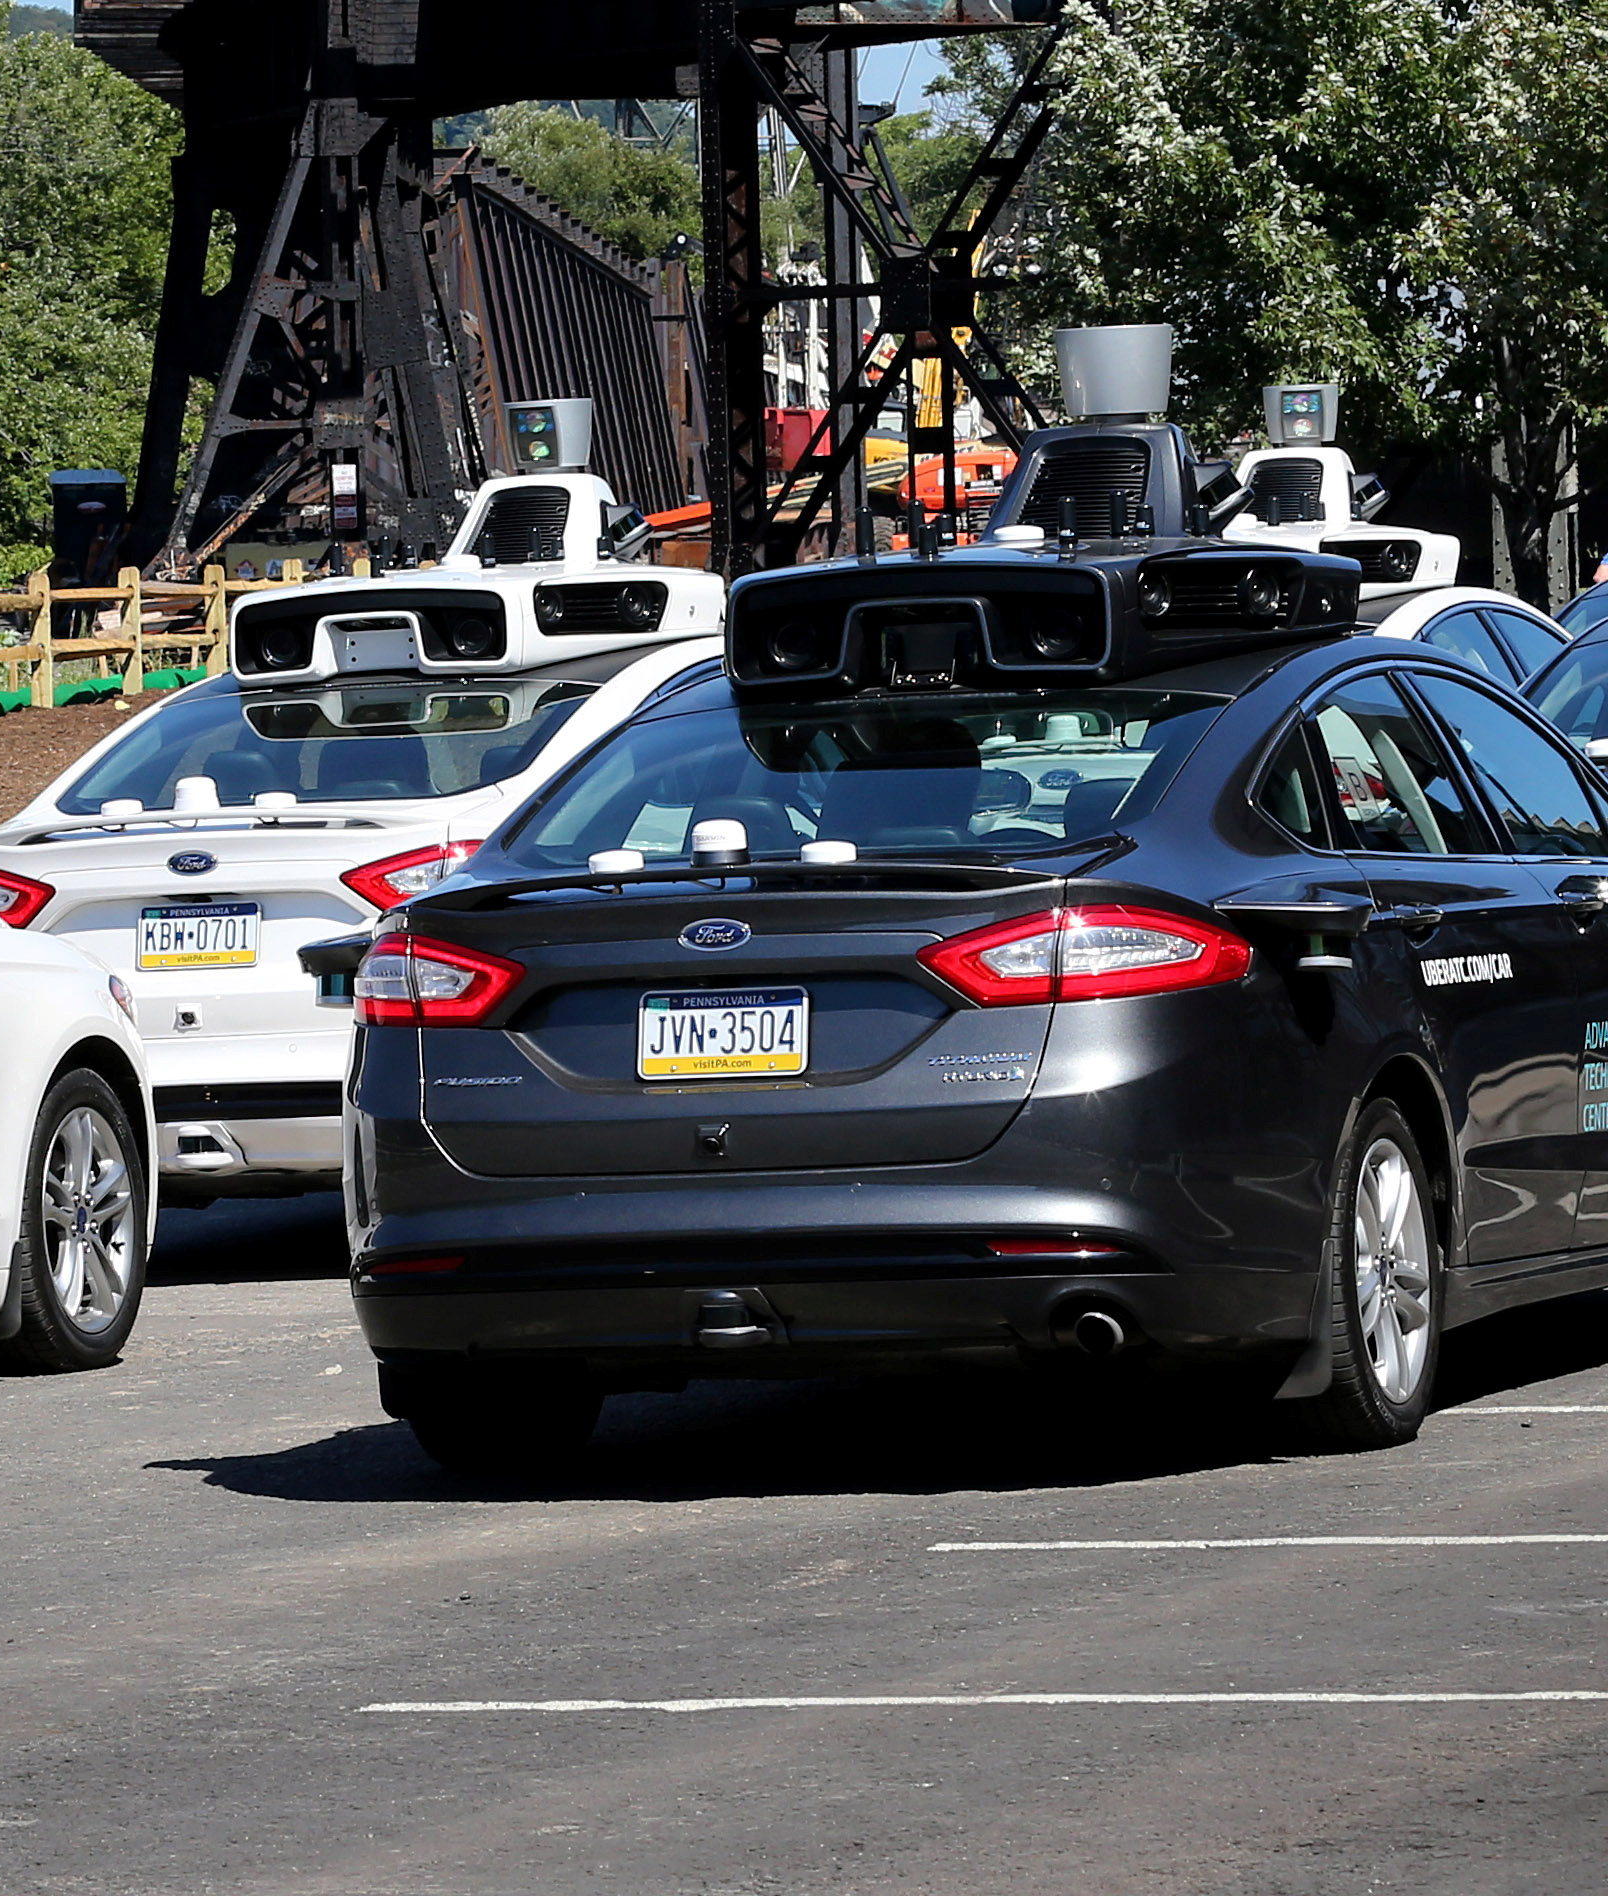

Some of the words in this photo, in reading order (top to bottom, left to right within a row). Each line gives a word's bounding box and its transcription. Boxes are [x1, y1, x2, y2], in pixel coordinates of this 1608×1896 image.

[169, 906, 230, 917] PENNSYLVANIA
[694, 924, 735, 944] Ford
[176, 954, 221, 964] visitPA.com
[1420, 952, 1513, 987] UBERATC.COM/CAR
[682, 994, 765, 1008] PENNSYLVANIA
[692, 1058, 752, 1069] visitPA.com
